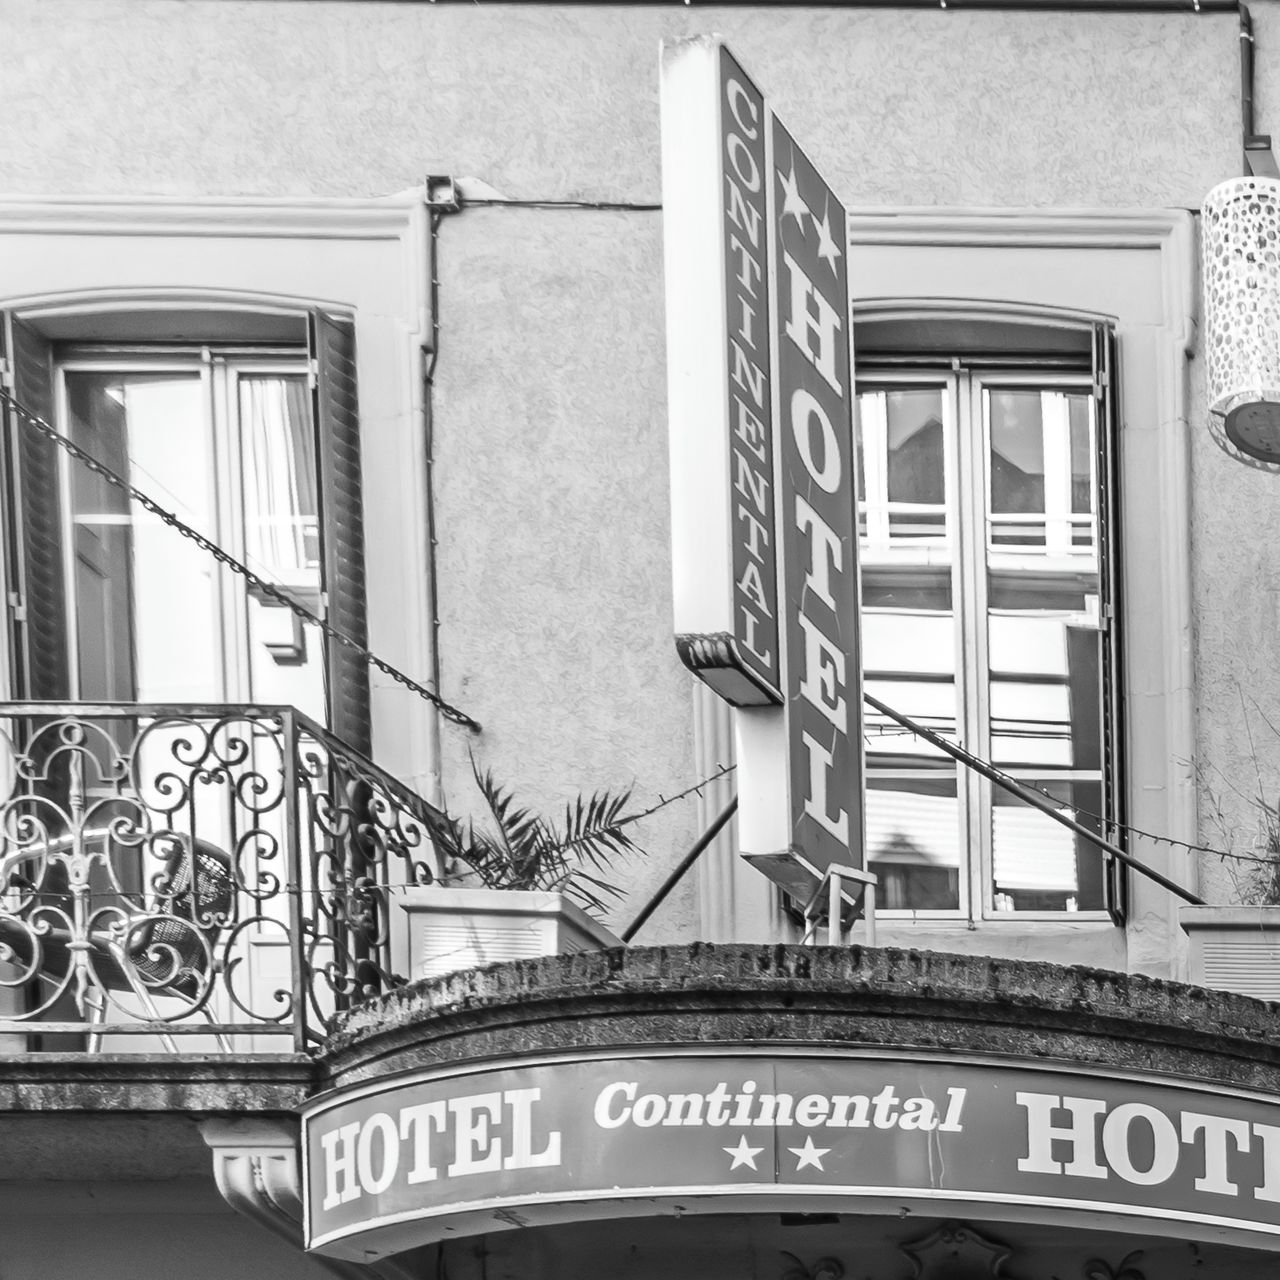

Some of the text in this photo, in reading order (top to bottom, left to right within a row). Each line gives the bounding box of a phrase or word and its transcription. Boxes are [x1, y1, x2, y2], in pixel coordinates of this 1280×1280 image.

[725, 78, 773, 668] CONTINENTAL
[784, 255, 849, 847] HOTEL
[321, 1087, 562, 1211] HOTEL
[593, 1080, 967, 1132] Continental
